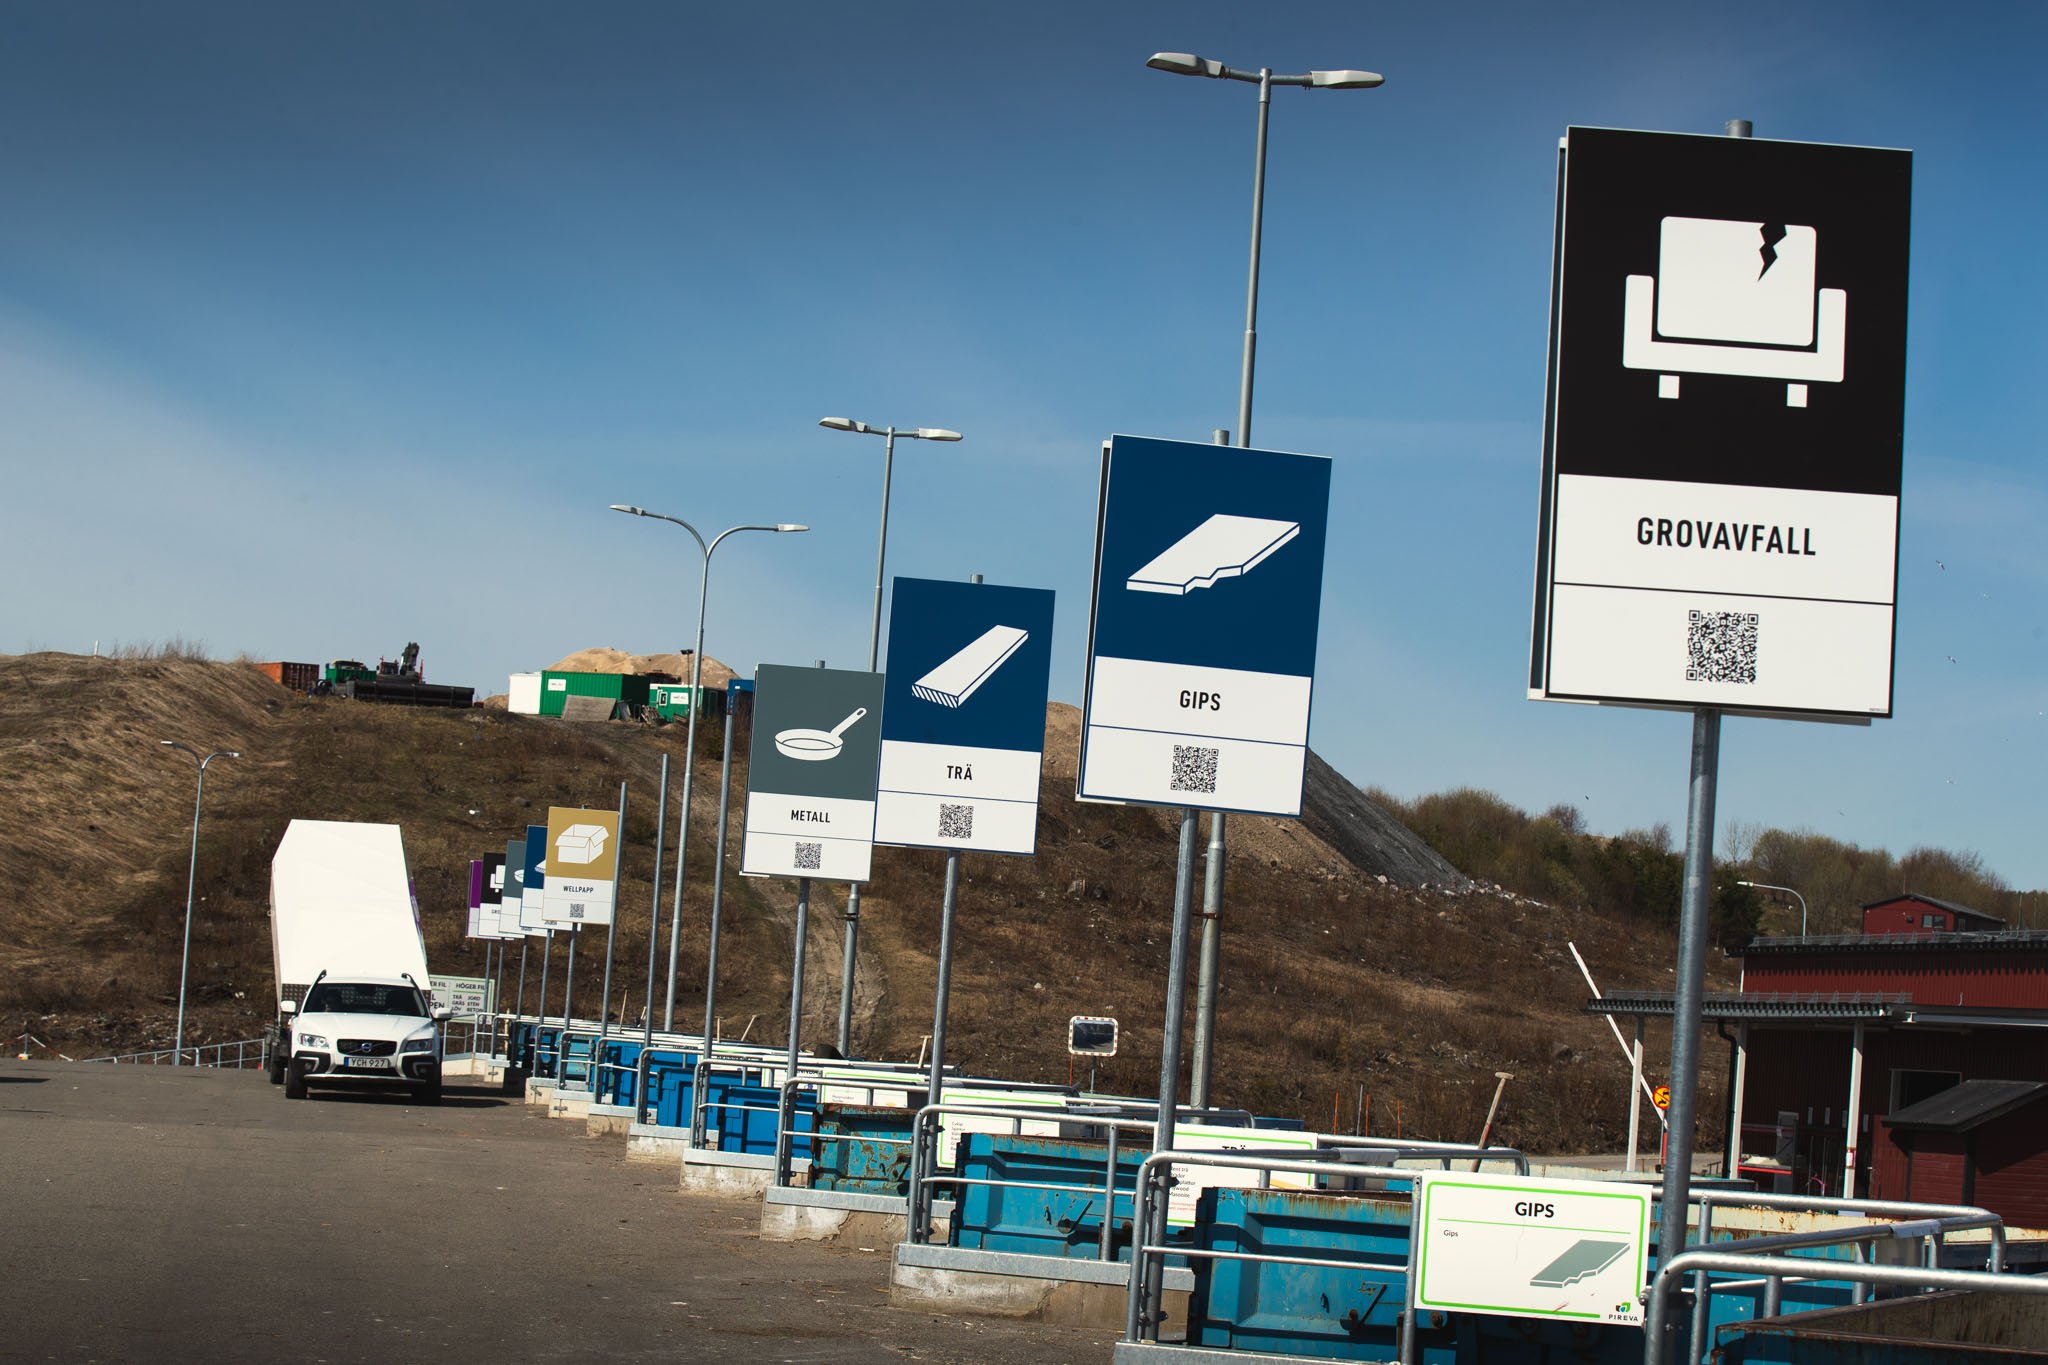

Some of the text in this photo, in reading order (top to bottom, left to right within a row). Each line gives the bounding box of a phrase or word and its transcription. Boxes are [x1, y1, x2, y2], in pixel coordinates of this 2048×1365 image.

[1637, 517, 1816, 556] GROVAVFALL
[1179, 689, 1221, 711] GIPS
[946, 763, 973, 781] TRÄ
[790, 809, 831, 824] METALL
[563, 885, 594, 894] WELLPAPP
[351, 1058, 385, 1068] YCH 927
[1515, 1201, 1555, 1219] GIPS
[1443, 1229, 1459, 1239] Gips
[1608, 1313, 1639, 1323] PIREVA
